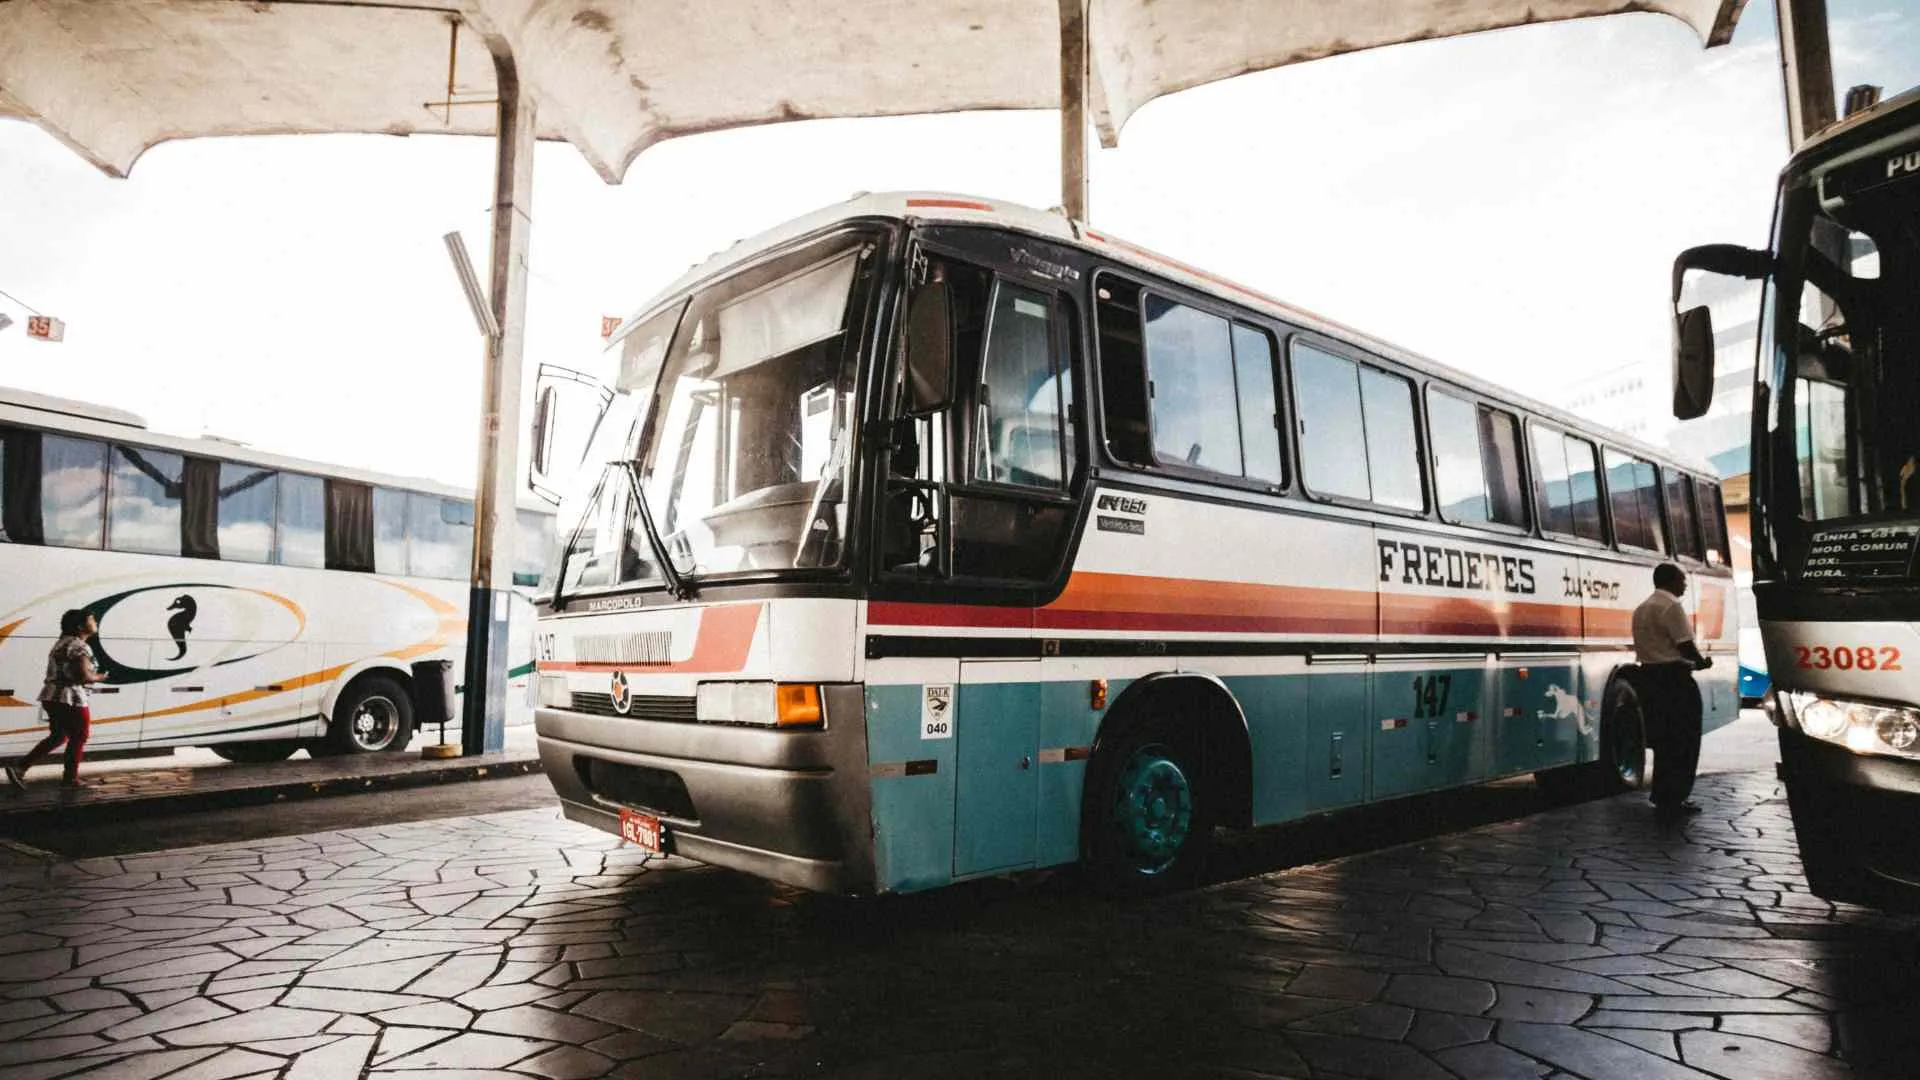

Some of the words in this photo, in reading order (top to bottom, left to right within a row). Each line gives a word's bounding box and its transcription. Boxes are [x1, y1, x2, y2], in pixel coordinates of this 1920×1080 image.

[30, 318, 50, 337] 35
[1850, 542, 1908, 552] COMUM
[589, 597, 642, 611] MARCOPOLO
[1793, 645, 1903, 671] 23082
[1413, 675, 1451, 718] 147
[927, 723, 947, 735] 040
